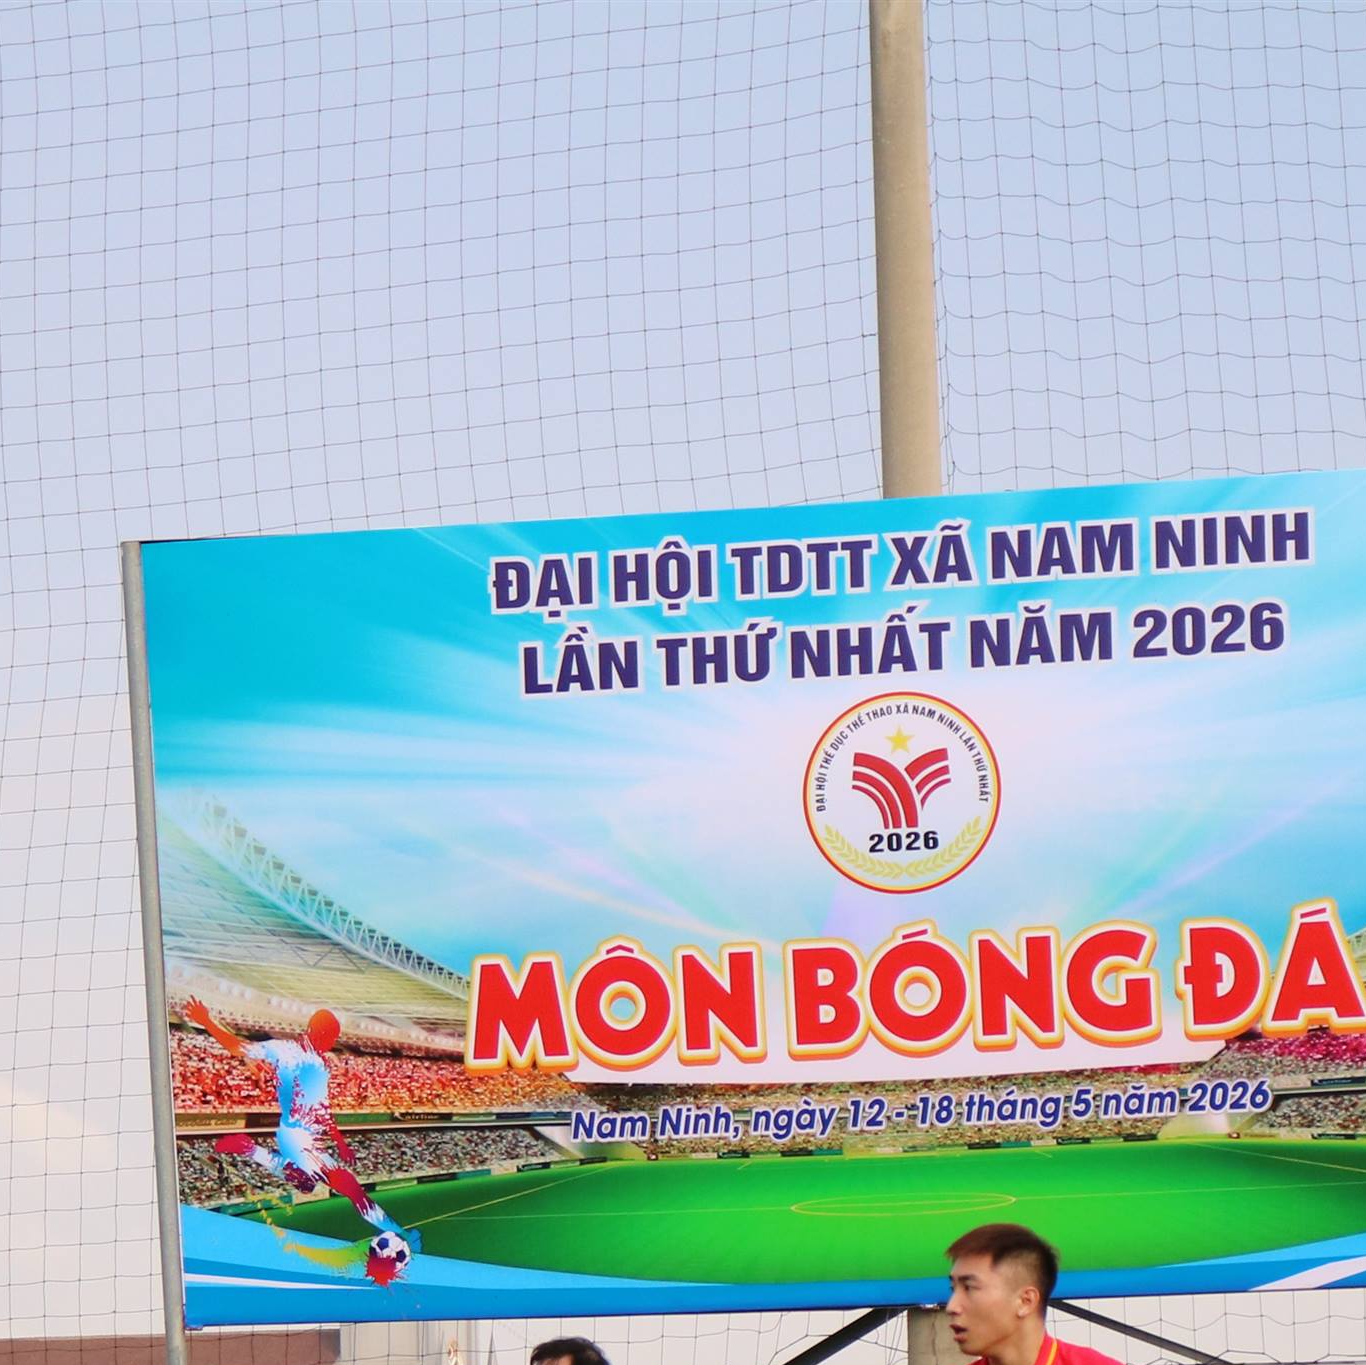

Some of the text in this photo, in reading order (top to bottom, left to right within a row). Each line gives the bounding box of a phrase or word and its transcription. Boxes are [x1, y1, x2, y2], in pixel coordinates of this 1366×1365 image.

[493, 511, 1310, 617] ĐẠI HỘI TDTT XÃ NAM NINH
[523, 602, 1285, 694] LẦN THỨ NHẤT NĂM 2026
[866, 705, 894, 722] THAO
[911, 705, 936, 719] NAM
[937, 712, 961, 735] NINH
[868, 830, 939, 854] 2026
[471, 941, 760, 1064] MÔN
[789, 925, 1155, 1052] BÓNG
[572, 1109, 649, 1141] Nam
[658, 1105, 741, 1141] Ninh,
[753, 1099, 837, 1142] ngày
[848, 1098, 885, 1129] 12
[918, 1096, 954, 1126] 18
[965, 1088, 1061, 1128] tháng
[1071, 1089, 1092, 1118] 5
[1102, 1082, 1177, 1116] năm
[1189, 1080, 1271, 1114] 2026
